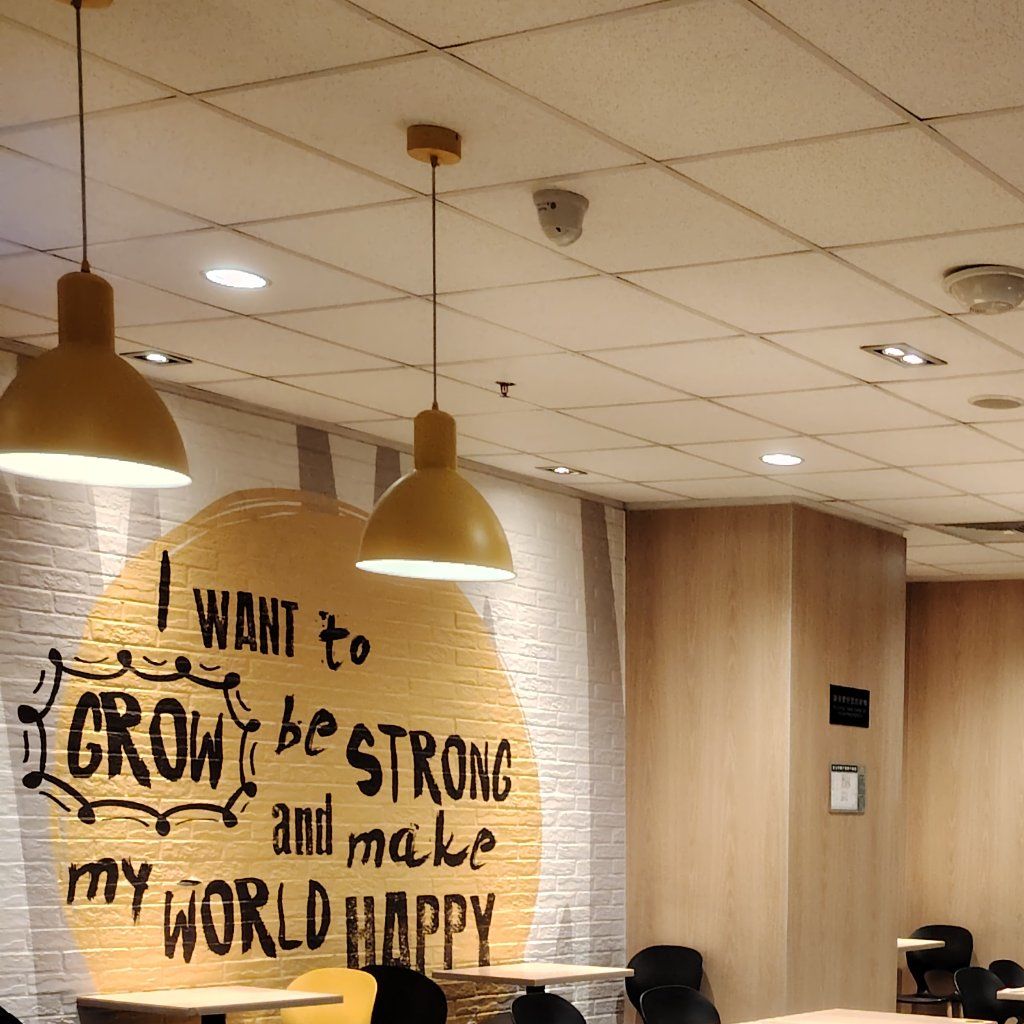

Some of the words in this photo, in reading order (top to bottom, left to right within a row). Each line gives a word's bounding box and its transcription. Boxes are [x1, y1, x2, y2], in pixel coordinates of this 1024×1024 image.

[157, 550, 171, 632] I
[193, 588, 299, 658] WANT
[318, 611, 371, 671] to
[67, 691, 224, 789] GROW
[274, 695, 339, 756] be
[346, 723, 512, 805] STRONG
[272, 793, 333, 856] and
[347, 810, 497, 870] make
[66, 856, 153, 925] my
[164, 877, 331, 963] WORLD
[346, 891, 496, 970] HAPPY
